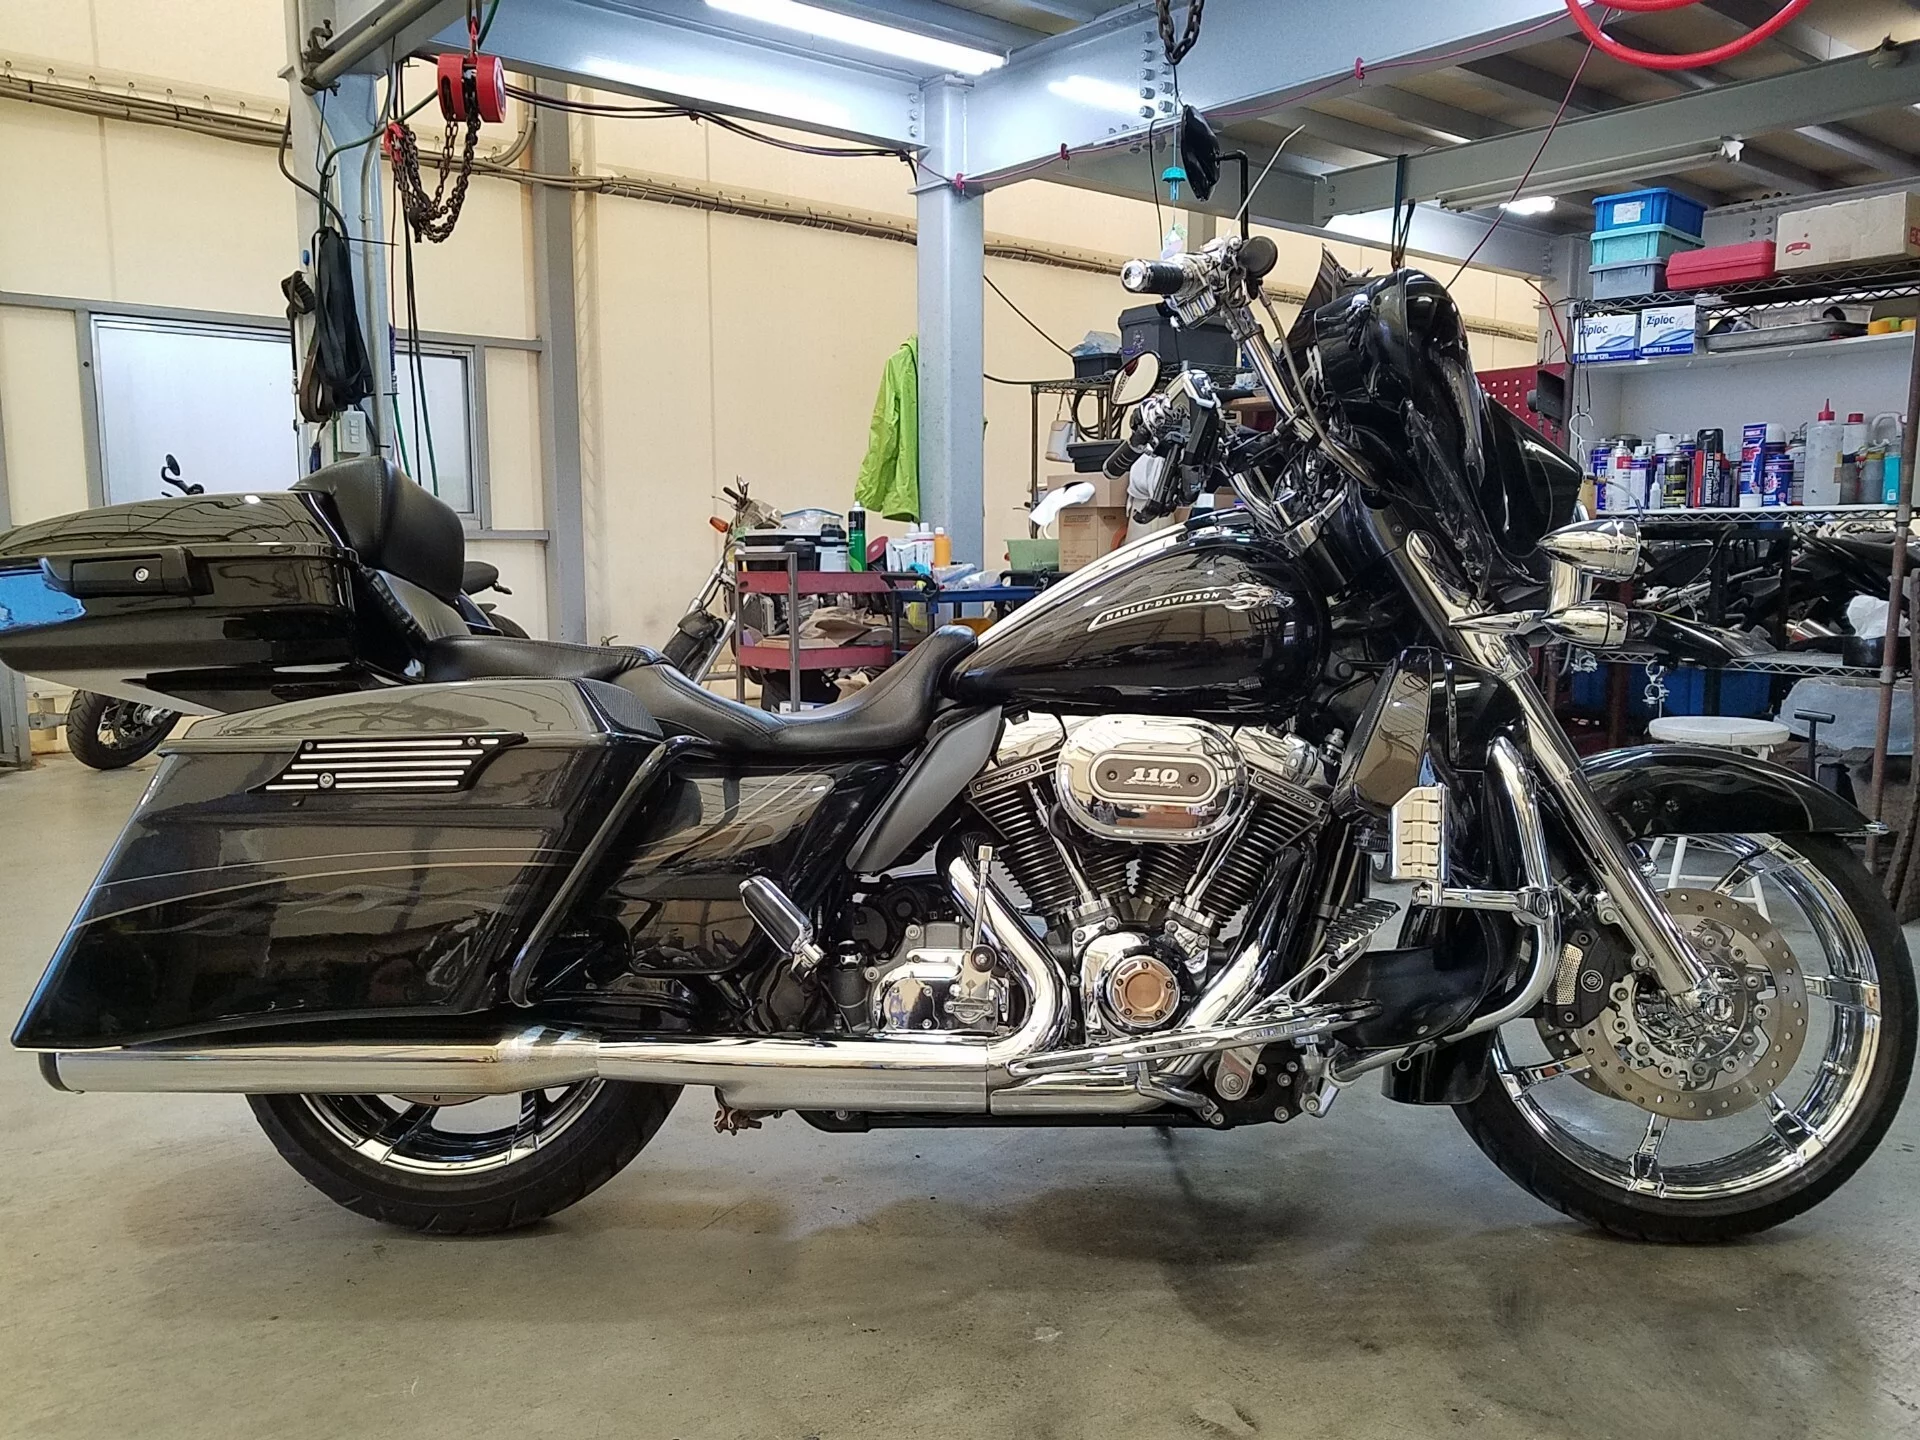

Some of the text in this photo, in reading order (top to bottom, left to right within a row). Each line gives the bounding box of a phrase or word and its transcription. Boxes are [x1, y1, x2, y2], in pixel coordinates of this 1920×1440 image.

[1646, 315, 1675, 328] Ziploc
[1580, 325, 1609, 338] Ziploc
[1105, 592, 1220, 621] HARLEY-DAVIDSON
[1131, 767, 1180, 783] 110
